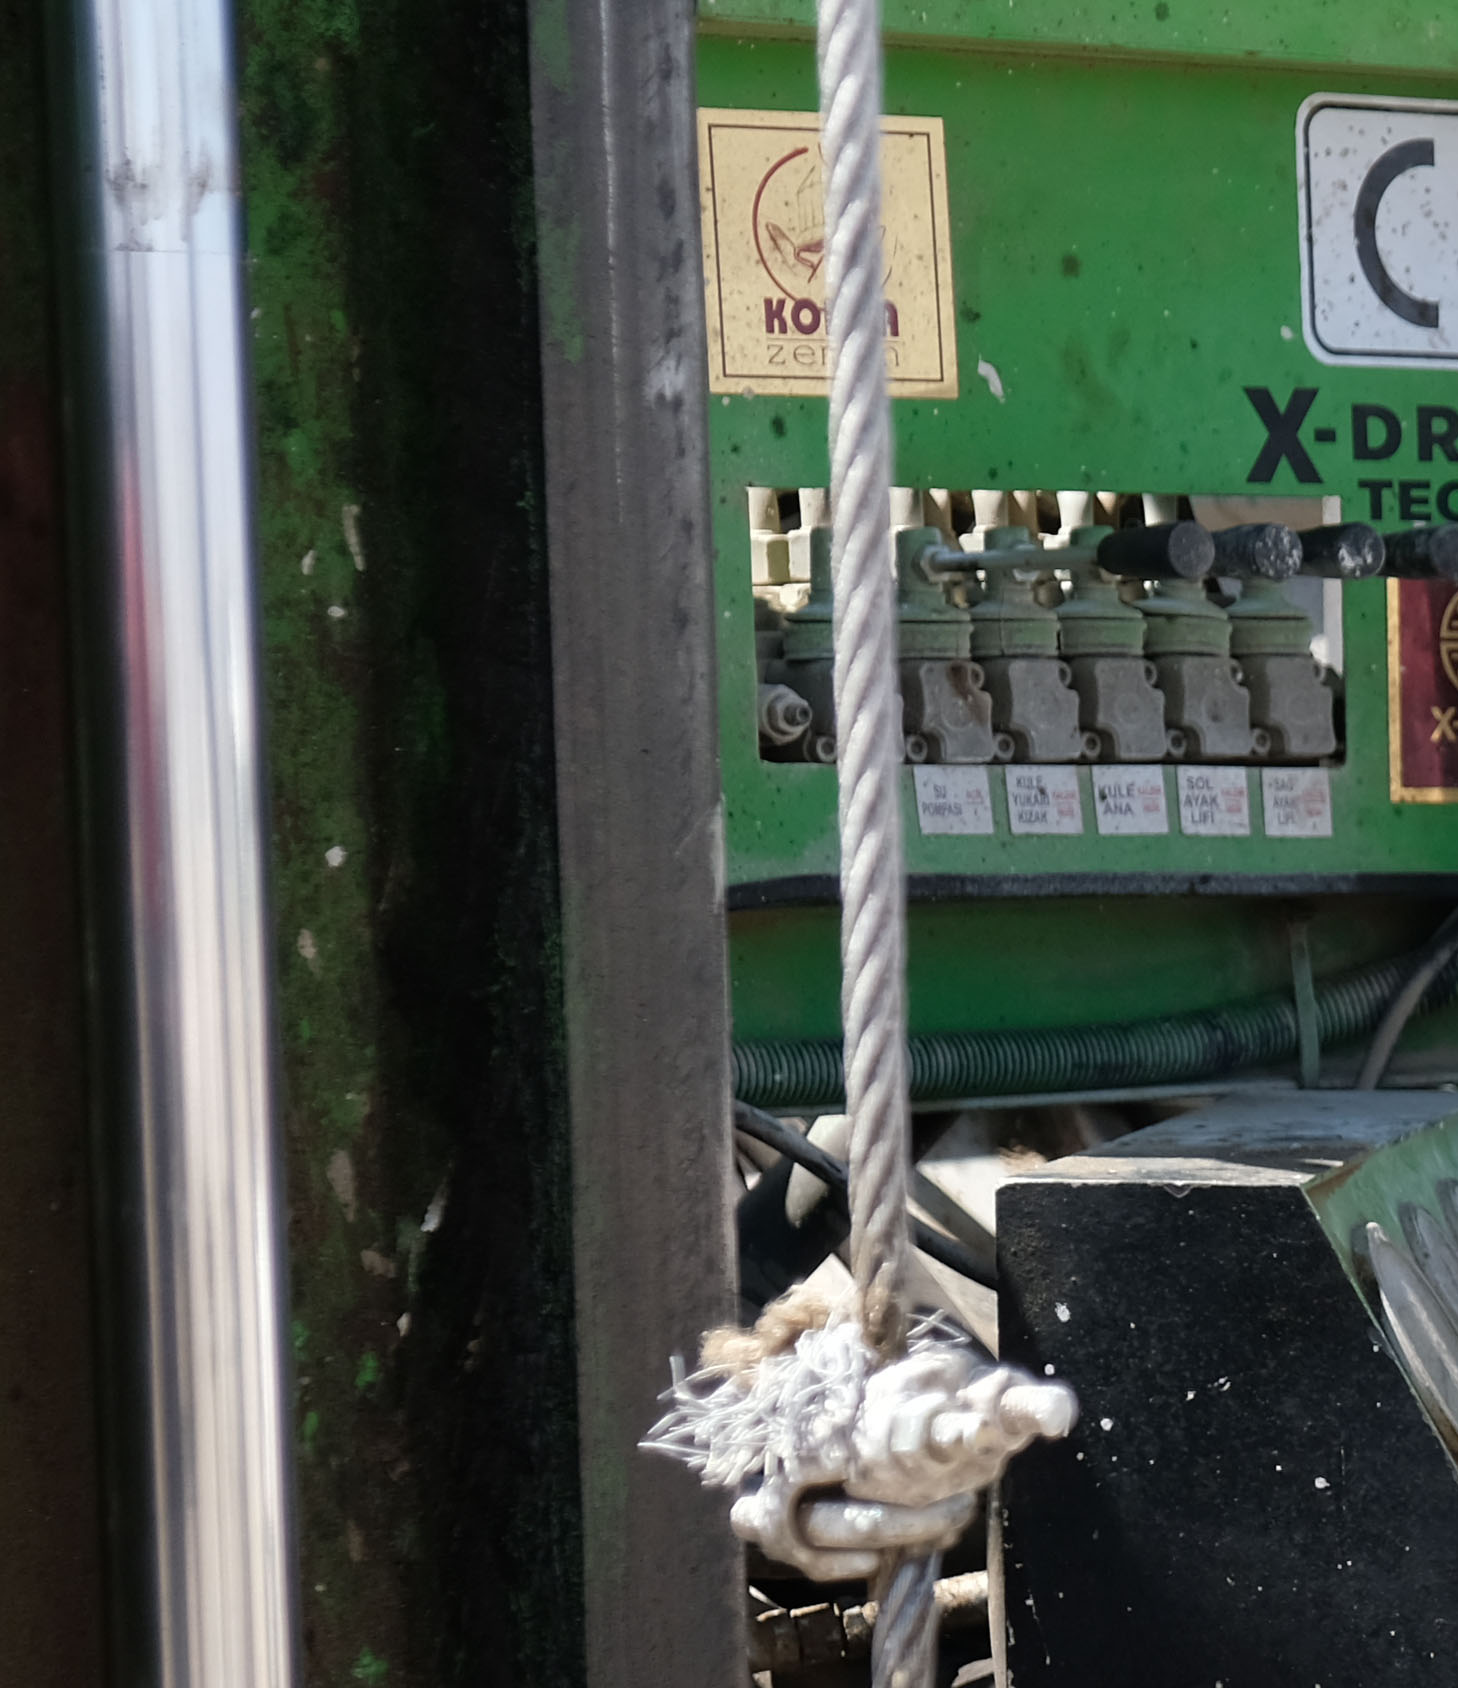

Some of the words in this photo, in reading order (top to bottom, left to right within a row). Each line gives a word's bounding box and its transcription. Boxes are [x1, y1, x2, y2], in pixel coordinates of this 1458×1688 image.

[1186, 776, 1213, 790] SOL
[1183, 793, 1220, 808] AYAK
[1103, 801, 1134, 816] ANA
